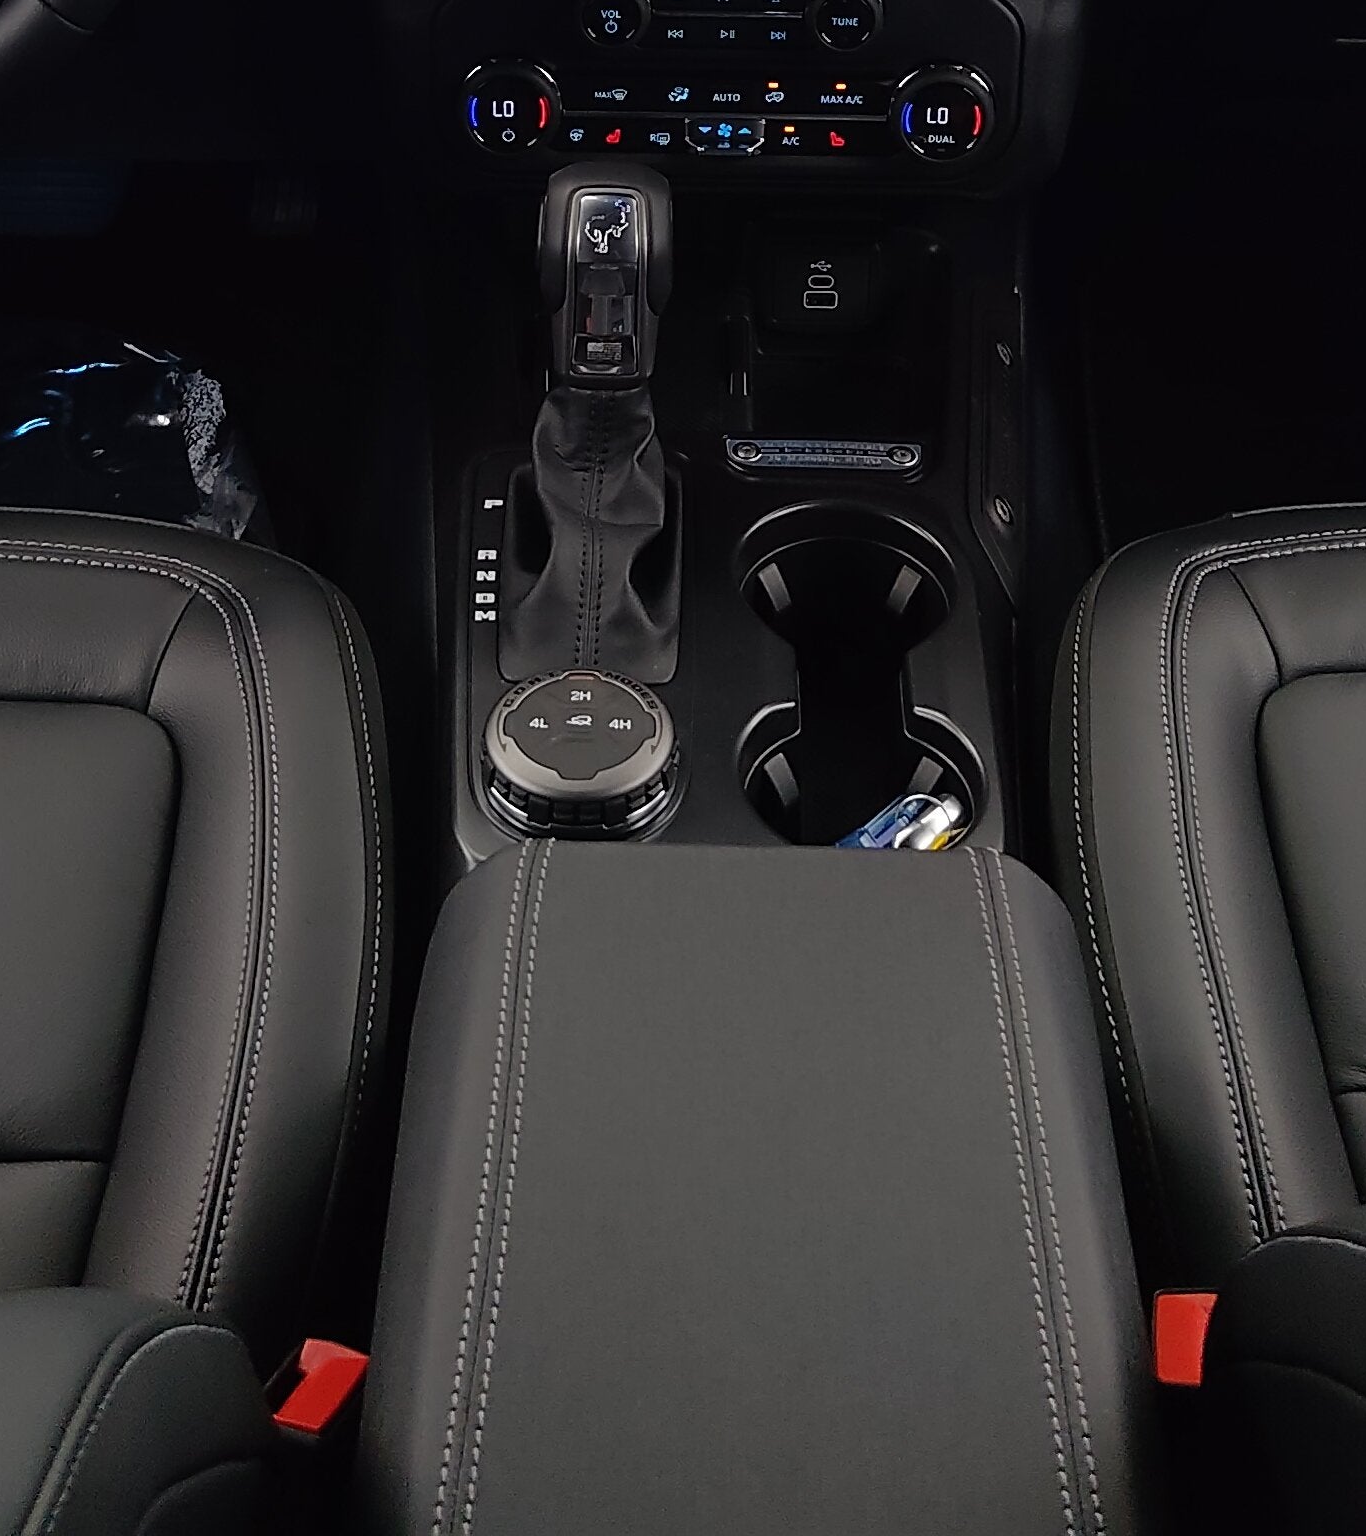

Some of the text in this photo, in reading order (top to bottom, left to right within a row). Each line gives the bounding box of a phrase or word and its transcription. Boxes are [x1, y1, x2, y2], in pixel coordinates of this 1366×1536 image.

[600, 9, 622, 19] VOL
[831, 17, 859, 26] TUNE
[594, 91, 611, 99] MAX
[713, 93, 741, 102] AUTO
[820, 95, 864, 105] MAX A/C
[493, 100, 515, 118] LO
[926, 107, 949, 125] LO
[782, 136, 800, 146] A/C
[928, 135, 956, 144] DUAL
[476, 570, 496, 581] N
[474, 610, 496, 621] M
[570, 690, 592, 702] 2H
[529, 717, 549, 729] 4L
[608, 718, 632, 730] 4H
